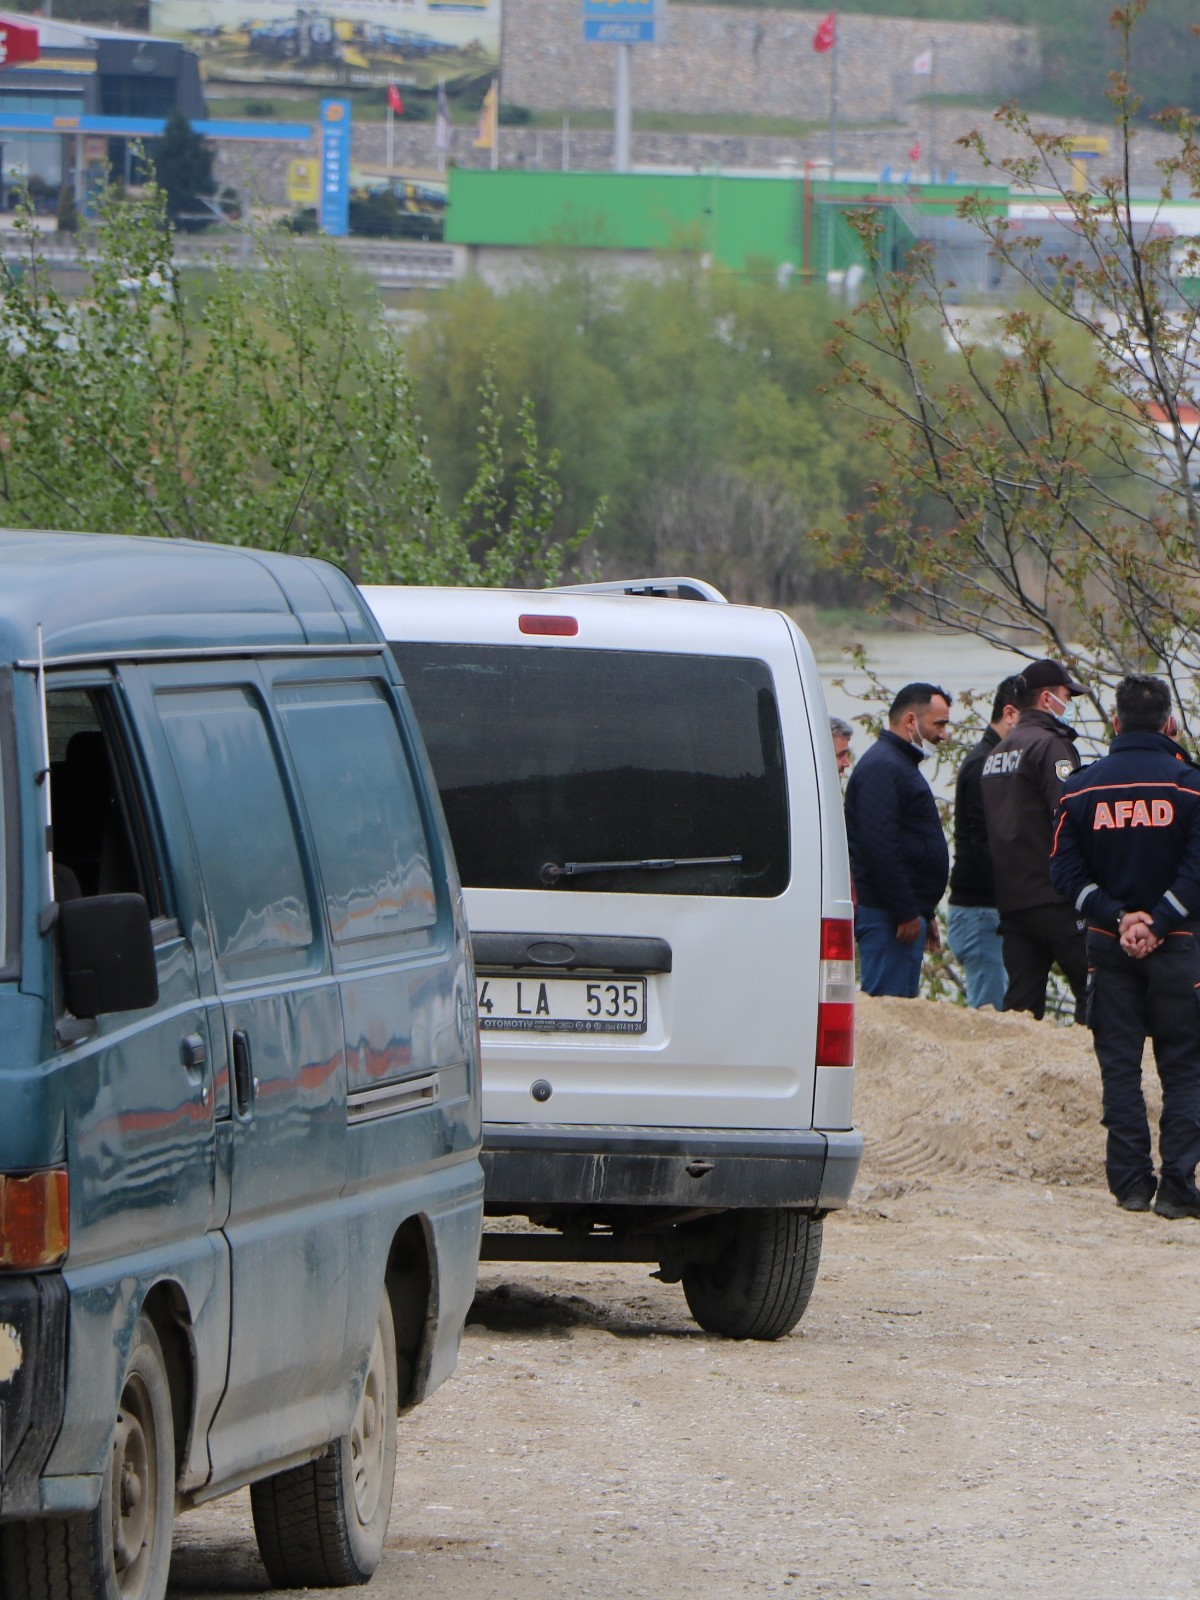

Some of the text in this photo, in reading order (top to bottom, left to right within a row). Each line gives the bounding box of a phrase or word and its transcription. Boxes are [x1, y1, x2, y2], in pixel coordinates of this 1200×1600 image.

[1093, 799, 1175, 830] AFAD
[479, 981, 638, 1017] 4 LA 535
